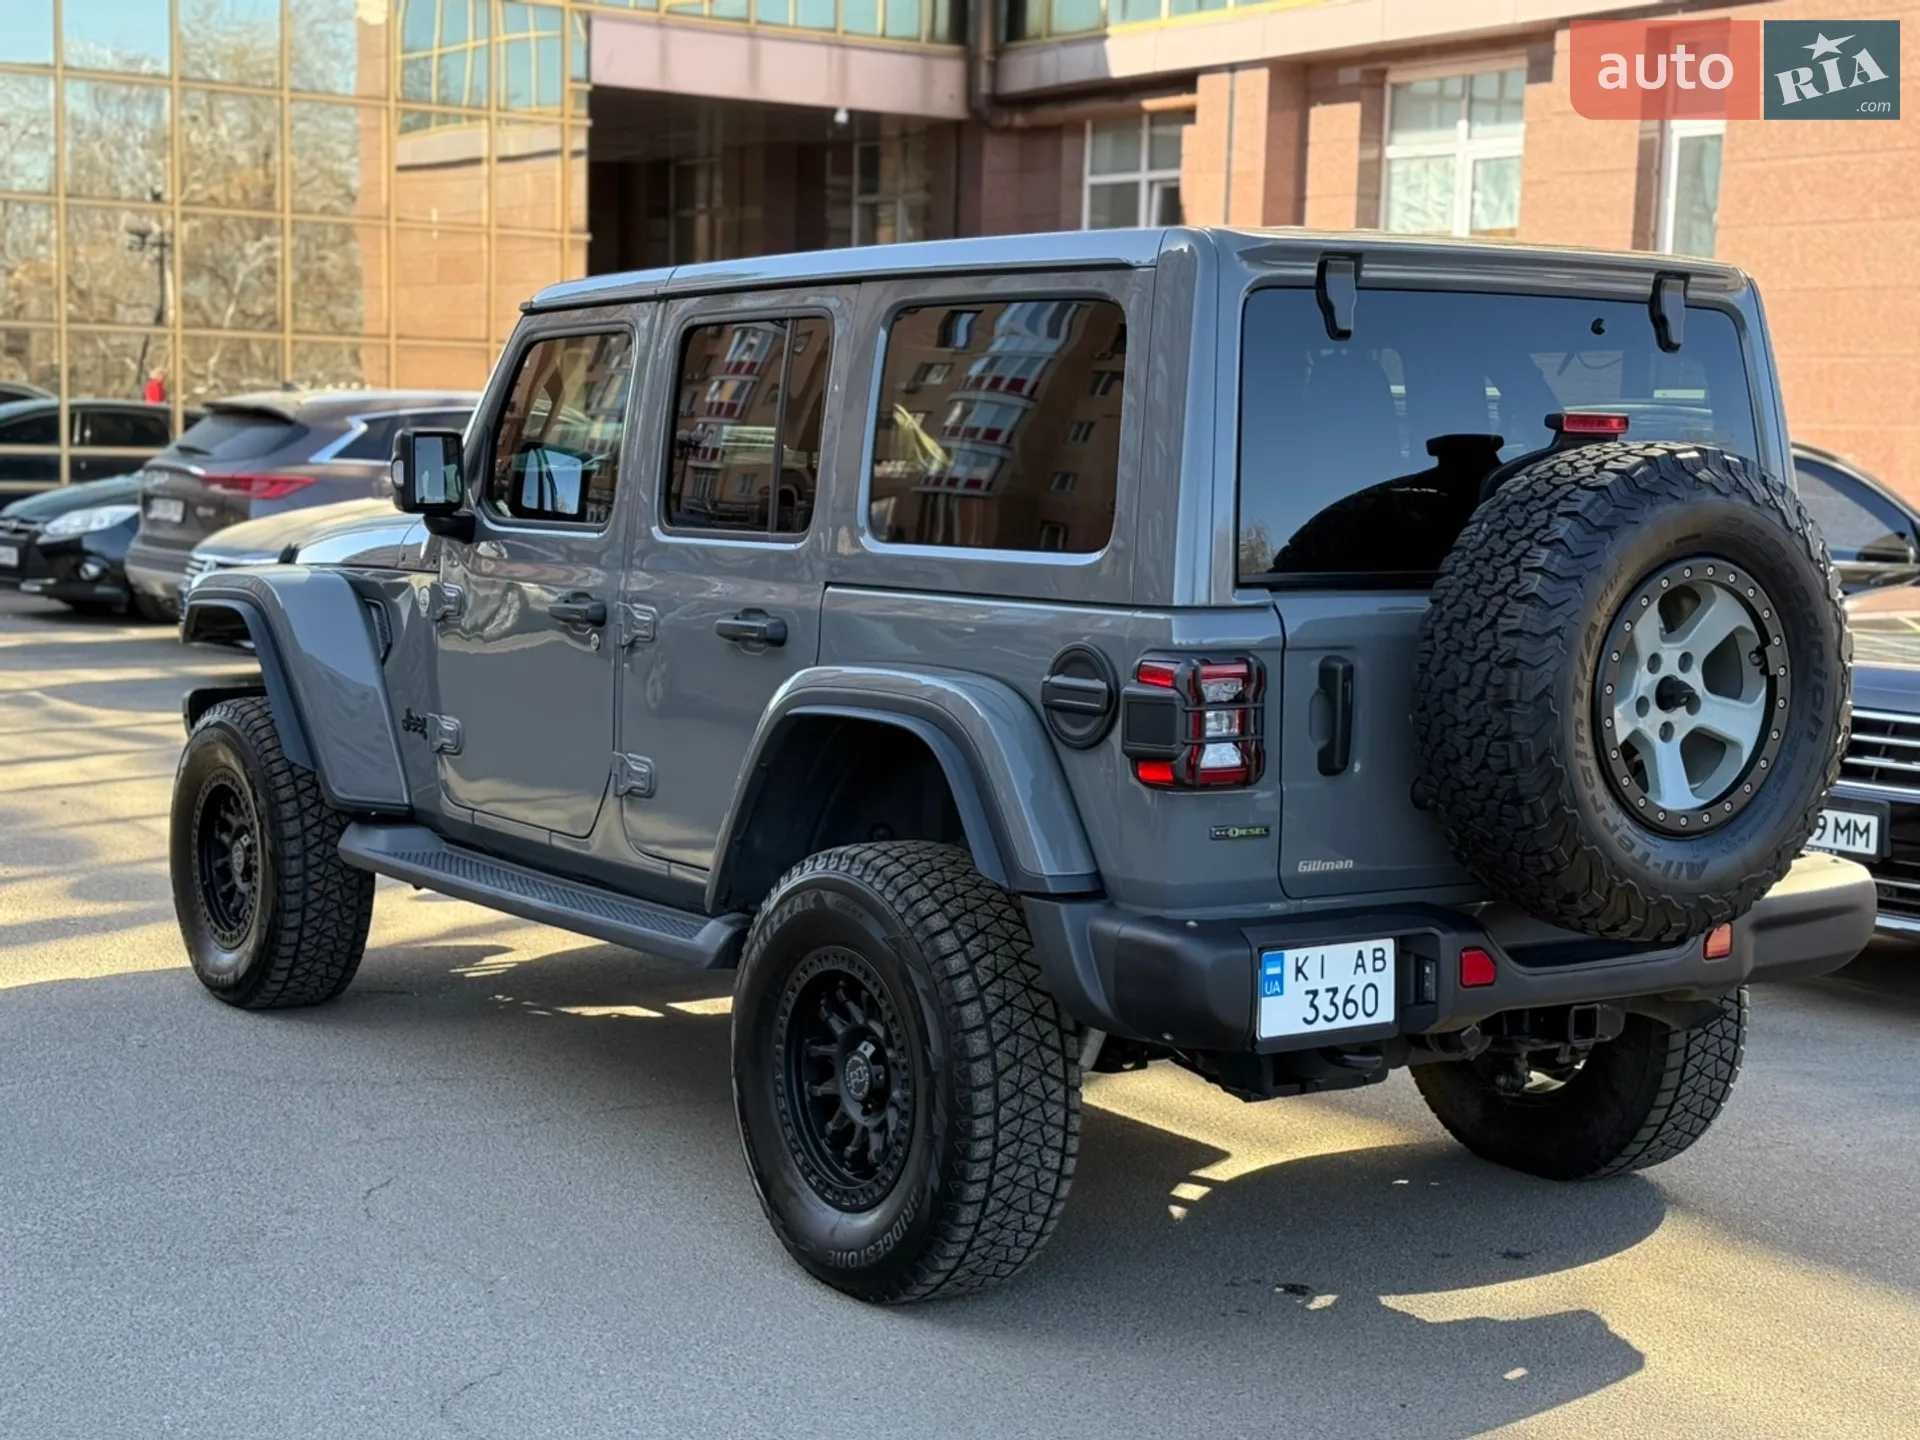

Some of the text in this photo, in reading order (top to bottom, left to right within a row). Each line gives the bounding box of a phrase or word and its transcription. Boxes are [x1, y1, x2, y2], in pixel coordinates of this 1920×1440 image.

[1833, 816, 1870, 849] MM
[1298, 859, 1353, 873] Gillman
[1295, 947, 1387, 982] KI AB
[1264, 980, 1280, 995] UA
[1302, 983, 1379, 1025] 3360
